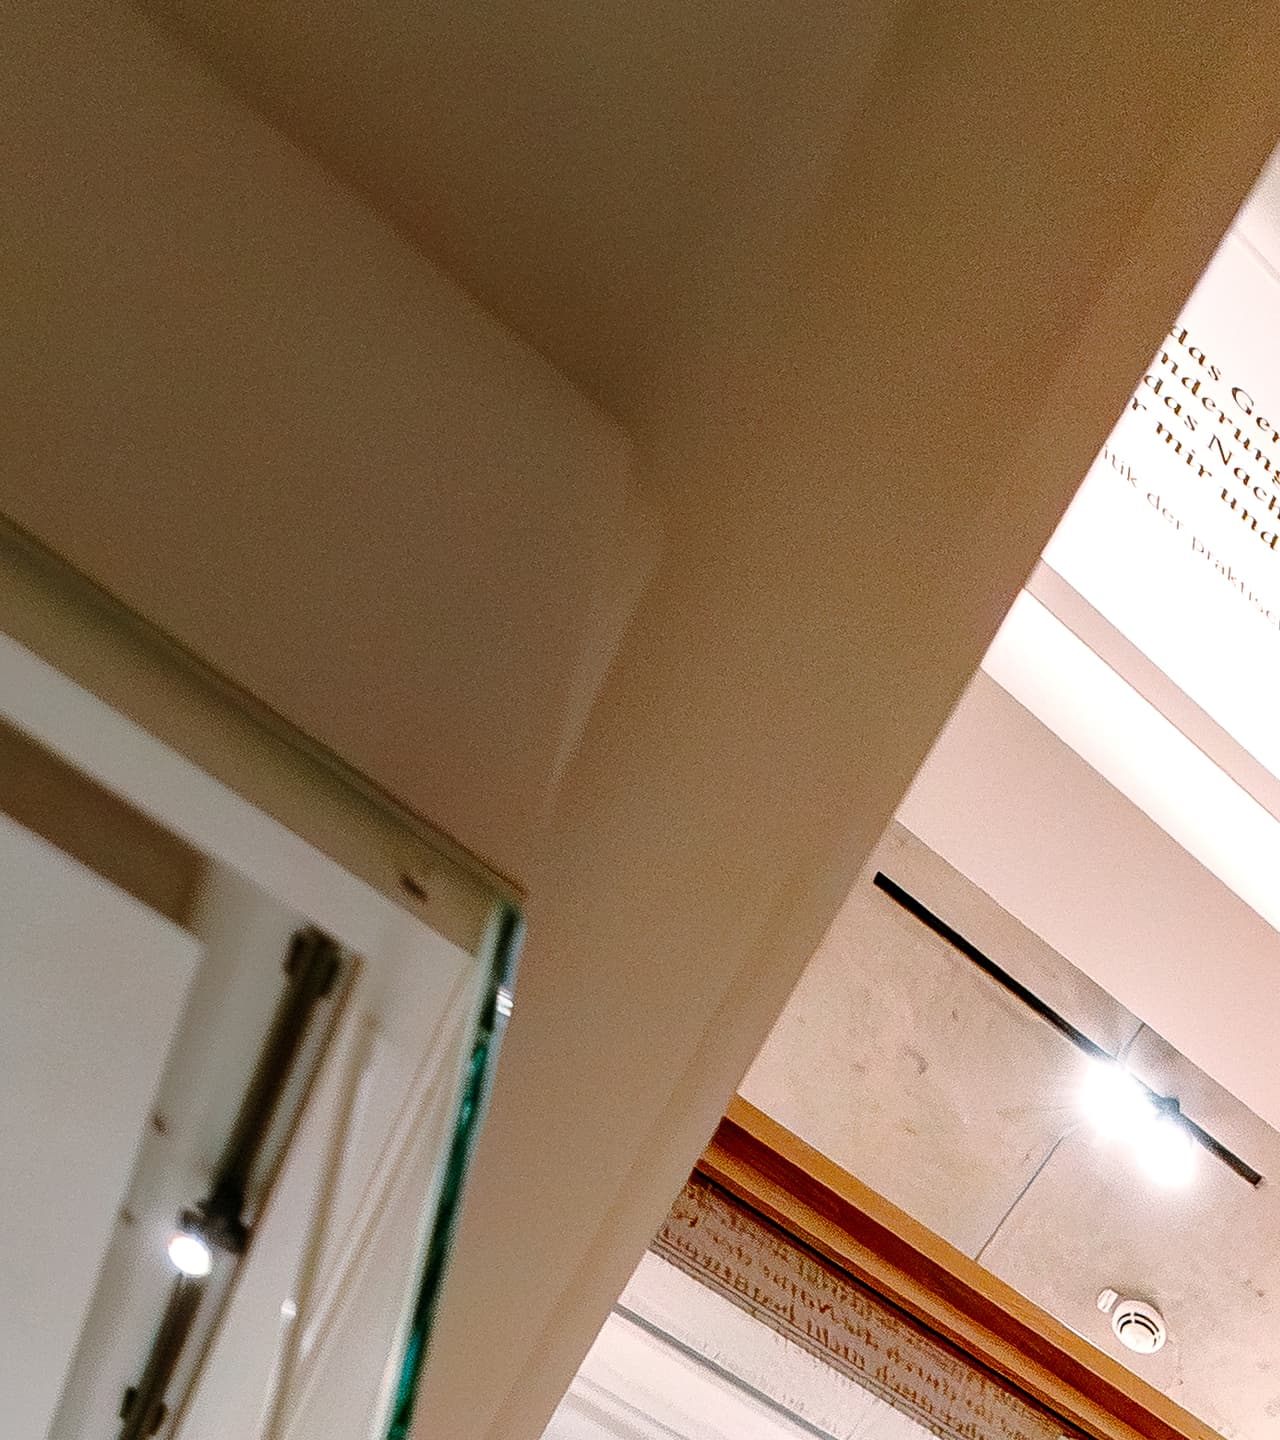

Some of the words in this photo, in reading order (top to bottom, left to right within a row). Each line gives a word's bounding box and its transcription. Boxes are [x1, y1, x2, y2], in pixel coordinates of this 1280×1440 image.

[1170, 324, 1224, 382] das
[1143, 373, 1200, 433] das
[1146, 490, 1186, 532] der
[1154, 419, 1214, 481] mir
[1218, 485, 1280, 553] und
